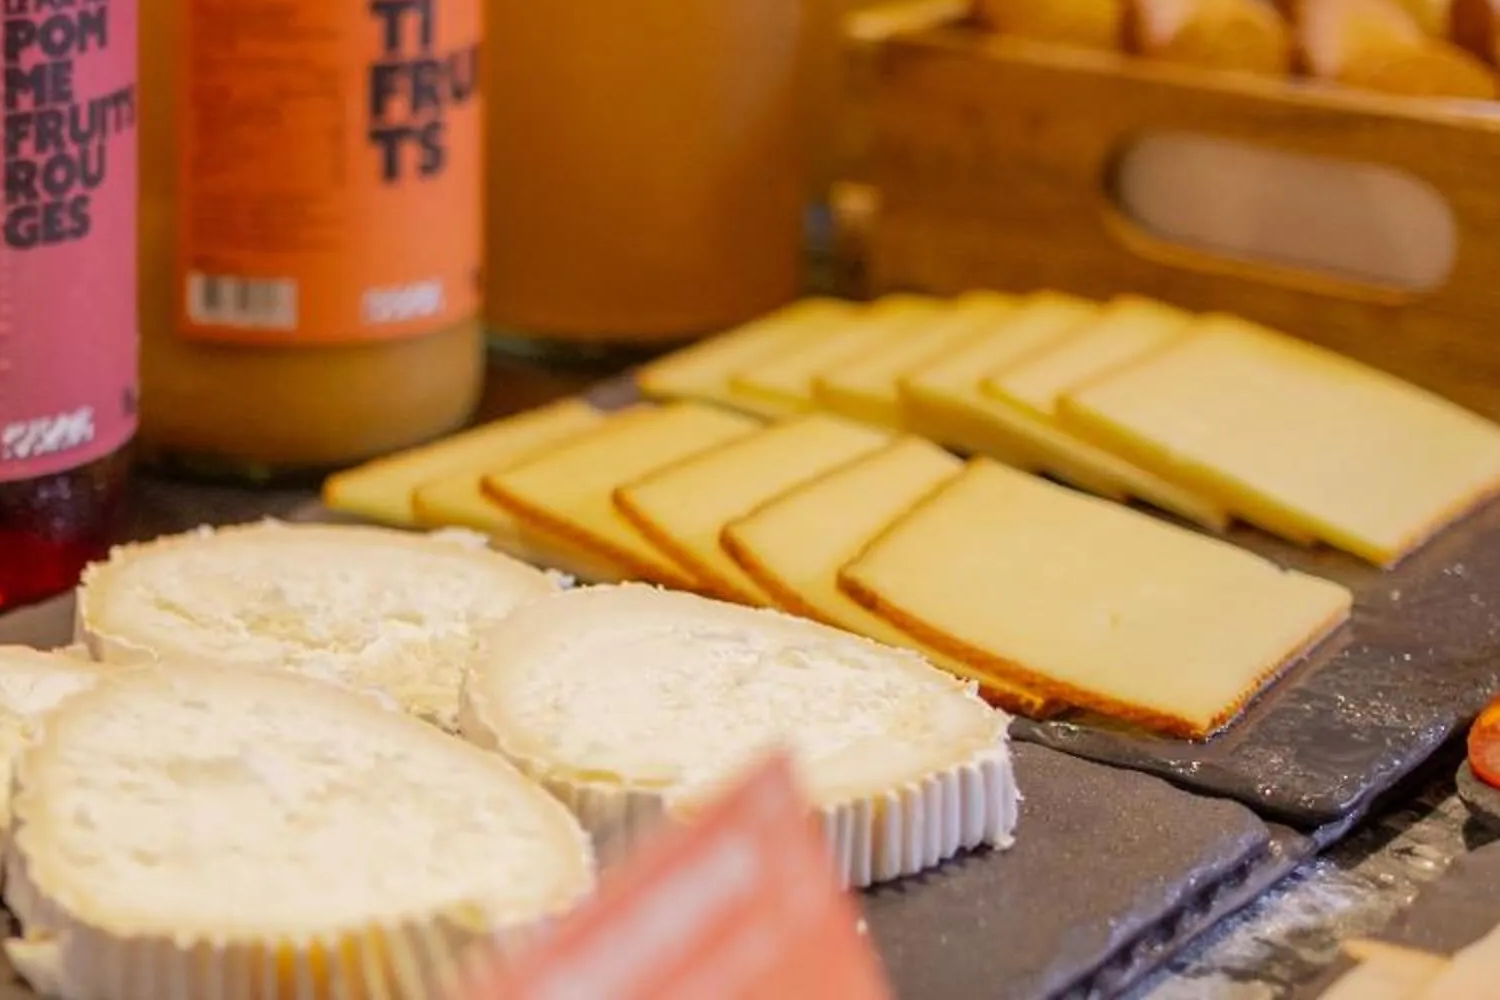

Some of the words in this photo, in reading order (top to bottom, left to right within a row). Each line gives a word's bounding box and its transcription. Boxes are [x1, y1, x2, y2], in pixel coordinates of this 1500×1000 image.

[3, 60, 74, 112] ME
[4, 144, 106, 205] ROU
[368, 121, 448, 182] TS
[4, 194, 91, 251] GES
